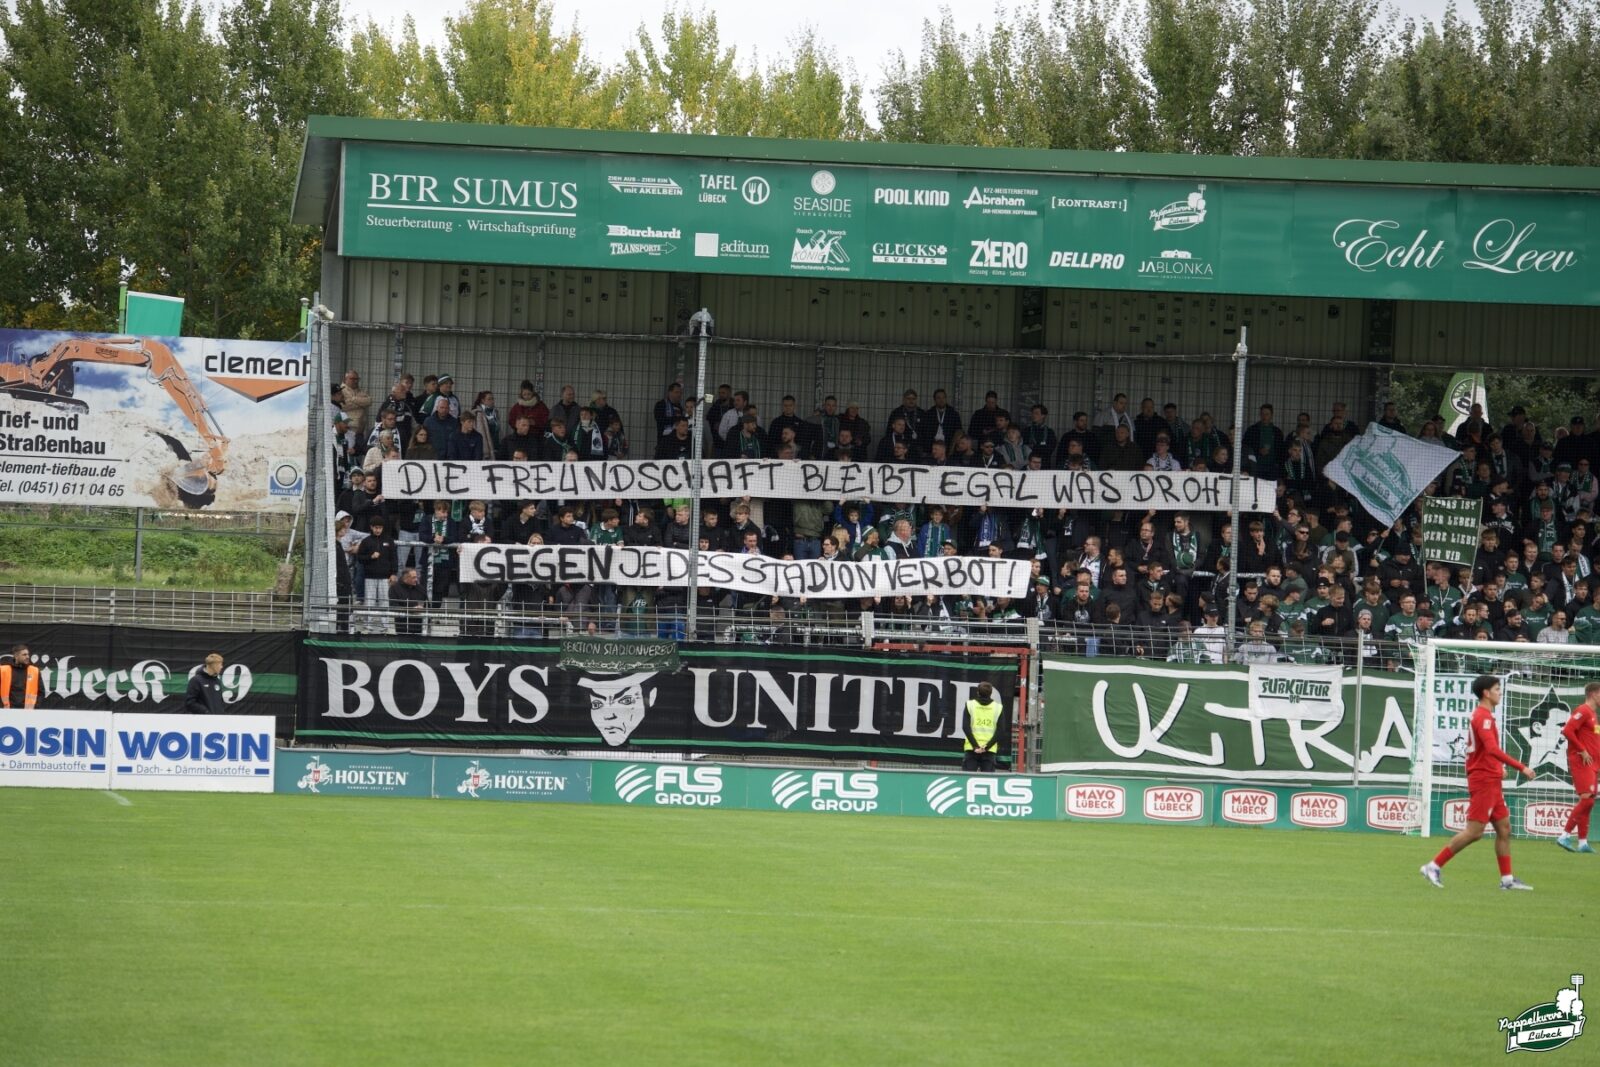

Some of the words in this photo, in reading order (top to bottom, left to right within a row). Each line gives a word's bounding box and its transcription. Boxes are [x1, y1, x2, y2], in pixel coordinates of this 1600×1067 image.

[700, 174, 737, 190] TAFEL
[368, 173, 440, 202] BTR
[452, 176, 578, 209] SUMUS
[699, 193, 727, 203] LÜBECK
[962, 186, 1025, 209] Abraham
[793, 197, 852, 212] SEASIDE
[366, 215, 453, 232] Steuerberatung
[467, 219, 576, 238] Wirtschaftsprüfung
[620, 226, 682, 239] Burchardt
[720, 240, 769, 254] aditum
[1332, 219, 1444, 272] Echt
[1462, 218, 1577, 274] Leev
[884, 256, 936, 264] EVENTS
[1049, 251, 1125, 270] DELLPRO
[1138, 261, 1213, 275] JABLONKA
[0, 410, 39, 429] Tief-
[42, 414, 79, 430] und
[0, 433, 106, 455] Straßenbau
[0, 461, 116, 478] lement-tiefbau.de
[0, 480, 14, 492] el.
[18, 480, 59, 497] (0451)
[62, 482, 85, 495] 611
[89, 483, 105, 496] 04
[108, 484, 125, 497] 65
[398, 461, 470, 495] DIE
[481, 460, 784, 497] FREUNDSCHAFT
[800, 463, 929, 504] BLEIBT,
[939, 470, 1038, 501] EGAL
[1052, 471, 1122, 504] WAS
[473, 544, 613, 583] GEGEN
[618, 547, 734, 584] JEDES
[563, 640, 601, 655] SEKTION
[318, 656, 550, 724] BOYS
[0, 726, 107, 757] OISIN
[118, 731, 269, 762] WOISIN
[9, 759, 87, 771] Dämmbaustoffe
[136, 764, 163, 774] Dach-
[175, 764, 251, 775] Dämmbaustoffe
[335, 770, 407, 785] HOLSTEN
[494, 775, 565, 790] HOLSTEN
[655, 766, 723, 793] FLS
[811, 772, 878, 799] FLS
[966, 777, 1033, 804] FLS
[655, 793, 722, 806] GROUP
[1076, 790, 1115, 800] MAYO
[1154, 792, 1194, 803] MAYO
[1232, 793, 1268, 805] MAYO
[811, 799, 878, 812] GROUP
[966, 804, 1033, 817] GROUP
[1076, 800, 1115, 809] LÜBECK
[1154, 803, 1193, 811] LÜBECK
[1232, 805, 1267, 815] LÜBECK
[1300, 799, 1338, 809] MAYO
[1377, 801, 1418, 812] MAYO
[1300, 808, 1337, 818] LÜBECK
[1534, 818, 1566, 828] LÜBEC
